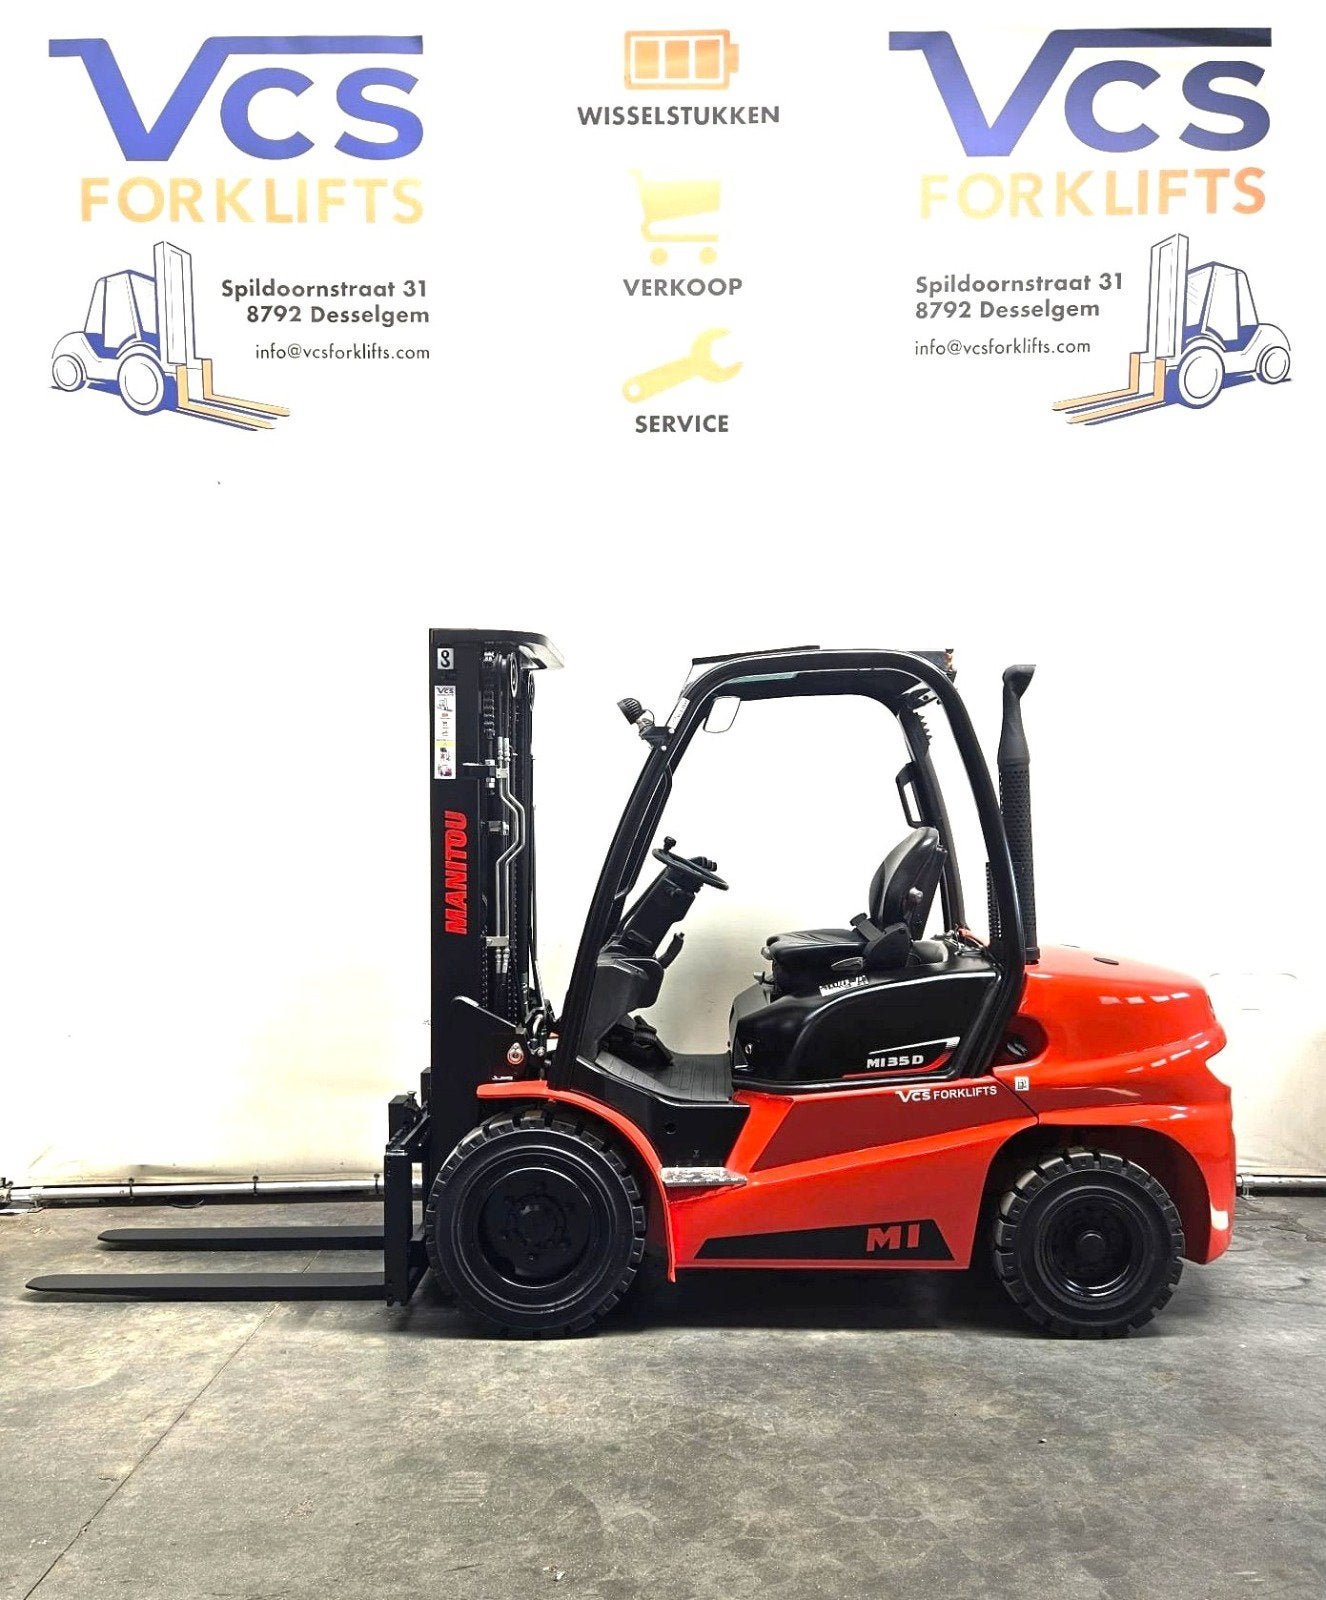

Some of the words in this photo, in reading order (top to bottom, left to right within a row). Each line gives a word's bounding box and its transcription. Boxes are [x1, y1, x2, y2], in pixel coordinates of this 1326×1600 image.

[48, 35, 423, 161] VCS
[889, 27, 1272, 157] VCS
[577, 106, 779, 125] WISSELSTUKKEN
[80, 176, 424, 224] FORKLIFTS
[920, 166, 1266, 220] FORKLIFTS
[222, 278, 395, 302] Spildoornstraat
[403, 280, 426, 297] 31
[623, 278, 742, 296] VERKOOP
[916, 274, 1091, 297] Spildoornstraat
[1099, 272, 1122, 290] 31
[247, 306, 301, 323] 8792
[310, 304, 429, 327] Desselgem
[916, 301, 971, 319] 8792
[981, 298, 1099, 322] Desselgem
[256, 342, 429, 360] info@vcsforklifts.com
[915, 337, 1090, 356] info@vcsforklifts.com
[636, 415, 729, 433] SERVICE
[445, 810, 467, 935] MANITOU
[896, 1089, 931, 1103] VCS
[933, 1086, 997, 1100] FORKLIFTS
[866, 1224, 920, 1252] MI
